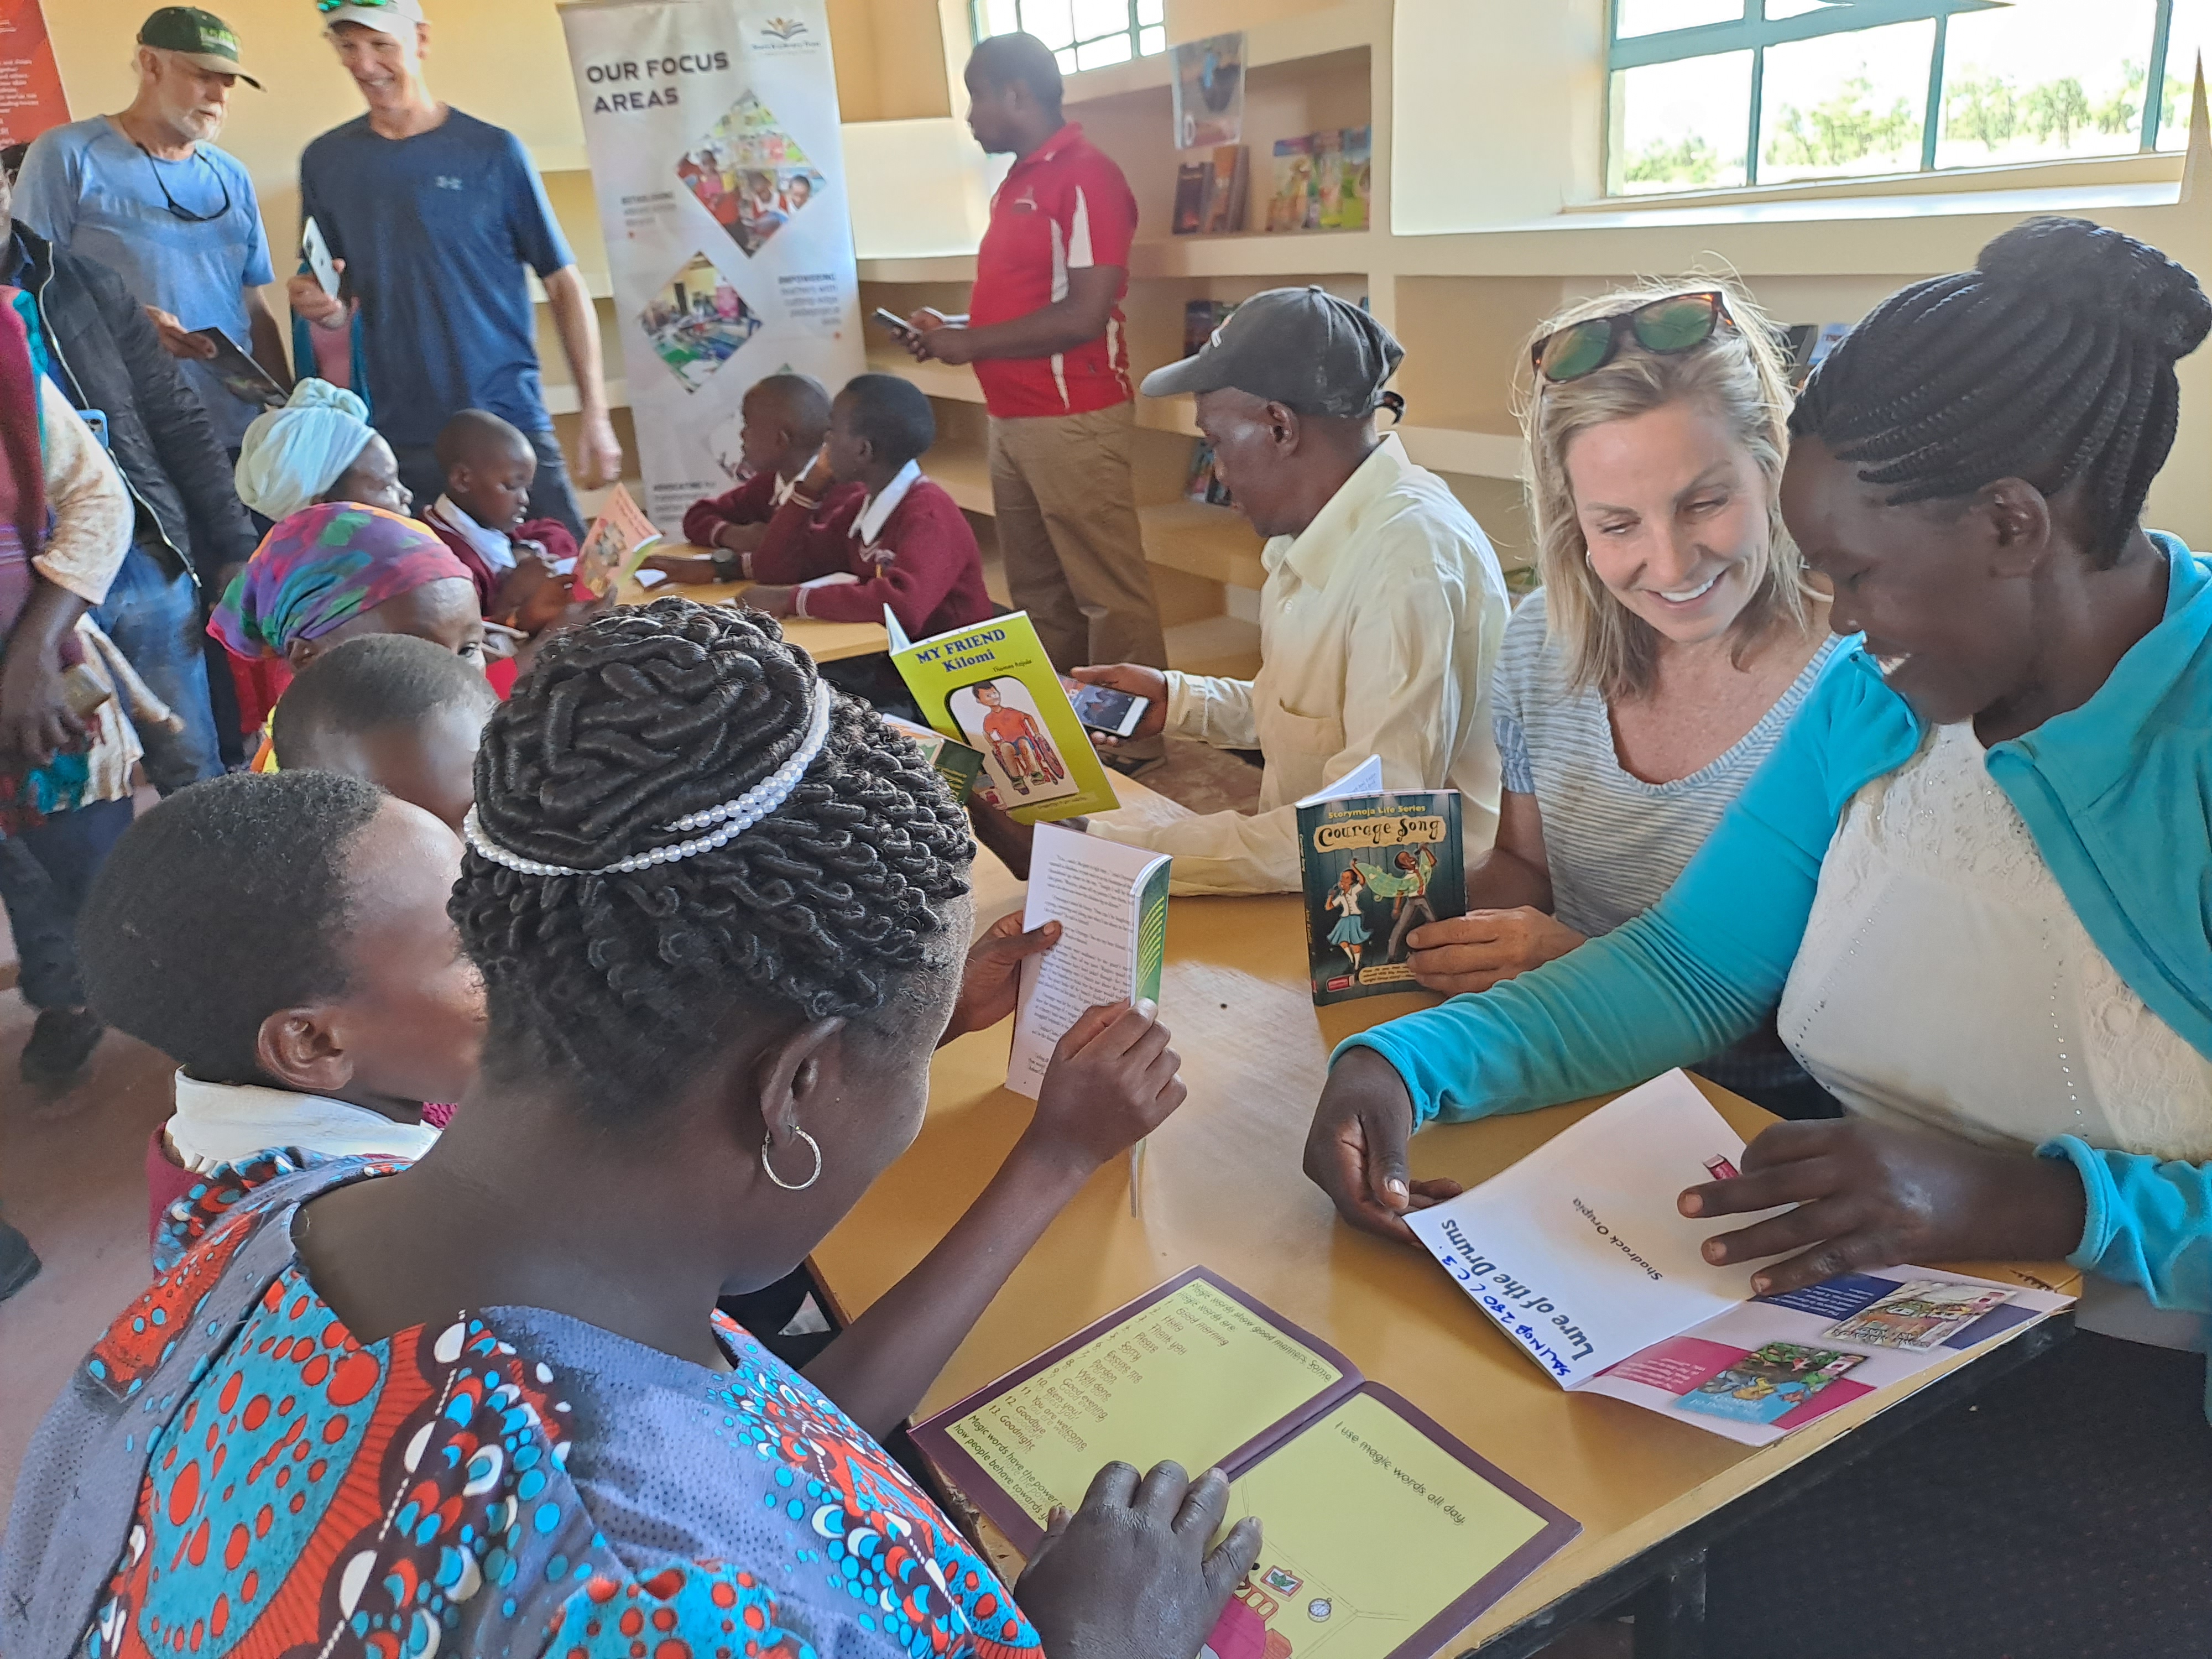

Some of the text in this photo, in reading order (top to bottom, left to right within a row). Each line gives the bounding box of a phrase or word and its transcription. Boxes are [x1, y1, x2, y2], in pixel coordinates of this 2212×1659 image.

[587, 51, 729, 82] OUR FOCUS
[593, 87, 679, 113] AREAS
[915, 629, 1006, 664] MY FRIEND
[941, 649, 995, 672] Kilomi
[1328, 805, 1426, 819] Storymoja Life Series
[1318, 818, 1441, 847] Courage Song
[1610, 1235, 1663, 1280] Shadrack
[1441, 1219, 1594, 1361] Lure of the Drums
[1176, 1307, 1199, 1324] Good
[1195, 1322, 1229, 1347] morning
[1189, 1282, 1211, 1300] Magic
[1210, 1295, 1234, 1314] words
[1233, 1311, 1255, 1327] show
[1250, 1325, 1275, 1342] good
[1198, 1303, 1223, 1322] words
[1118, 1340, 1142, 1363] Sorry
[1133, 1332, 1159, 1354] Please
[1149, 1322, 1173, 1344] Thank
[1167, 1340, 1187, 1355] you
[1077, 1368, 1096, 1385] Well
[1093, 1383, 1112, 1399] done
[1091, 1359, 1117, 1383] Pardon
[1104, 1350, 1131, 1374] Excuse
[1128, 1370, 1143, 1384] me
[1047, 1386, 1065, 1403] Bless
[1062, 1402, 1082, 1417] you!
[1062, 1378, 1084, 1396] Good
[1081, 1395, 1108, 1420] evening
[1000, 1415, 1035, 1450] Goodnight
[1016, 1405, 1046, 1435] Goodbye
[1032, 1395, 1044, 1409] You
[1044, 1408, 1057, 1420] are
[1057, 1419, 1088, 1447] welcome
[953, 1423, 969, 1438] how
[964, 1437, 990, 1461] people
[989, 1458, 1014, 1484] behave
[1013, 1483, 1044, 1514] towards
[968, 1415, 989, 1435] Magic
[988, 1433, 1008, 1454] words
[1006, 1452, 1024, 1471] have
[1022, 1469, 1036, 1483] the
[1032, 1480, 1058, 1504] power
[1334, 1420, 1465, 1524] I use magic words all day.
